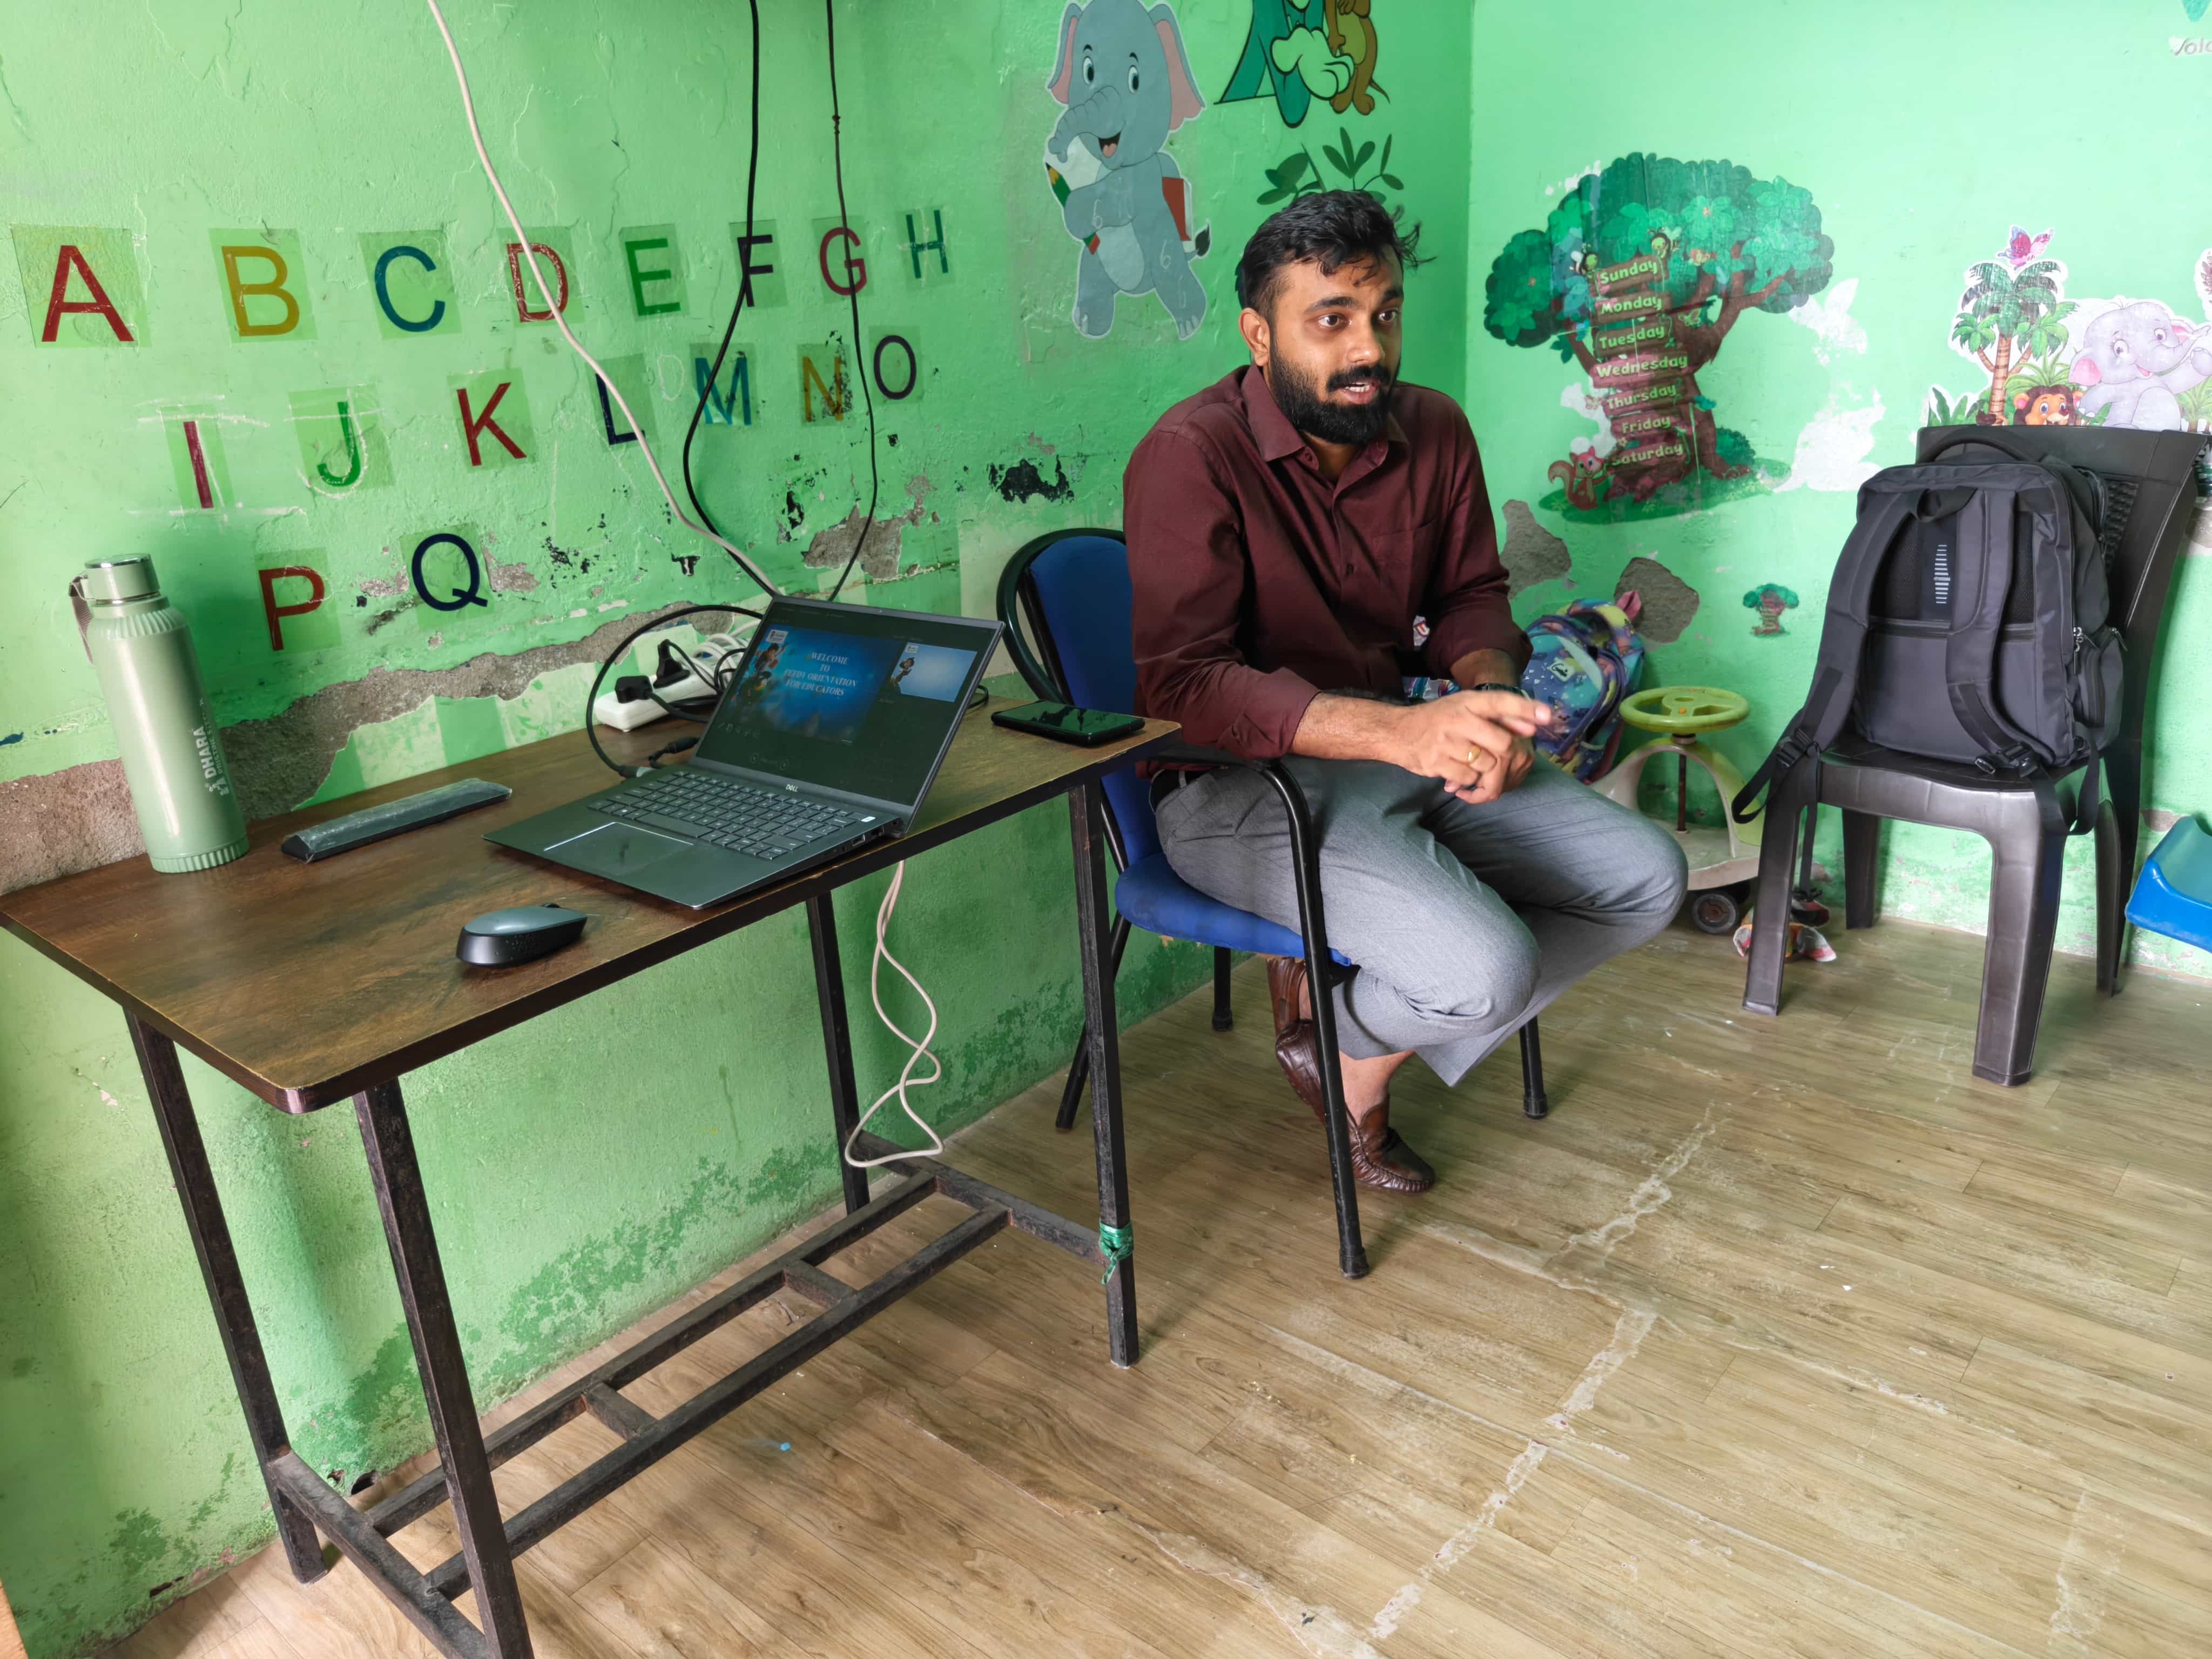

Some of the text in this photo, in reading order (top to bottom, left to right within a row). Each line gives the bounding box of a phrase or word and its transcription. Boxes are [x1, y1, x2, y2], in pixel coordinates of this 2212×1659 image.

[42, 210, 949, 342] A B C D E F G H
[1600, 259, 1658, 284] Sunday
[1601, 295, 1662, 315] Monday
[1599, 326, 1665, 349] Tuesday
[1596, 354, 1688, 377] Wednesday
[1607, 384, 1676, 410] Thursday
[184, 335, 917, 509] I J K L M N O
[1622, 416, 1671, 433] Friday
[1611, 444, 1684, 466] Saturday
[259, 533, 488, 651] P Q
[812, 652, 848, 665] WELCOME
[801, 682, 844, 696] EDUCATORS
[807, 673, 856, 687] ORIENTATION
[193, 726, 217, 779] DHARA
[786, 784, 798, 792] DELL
